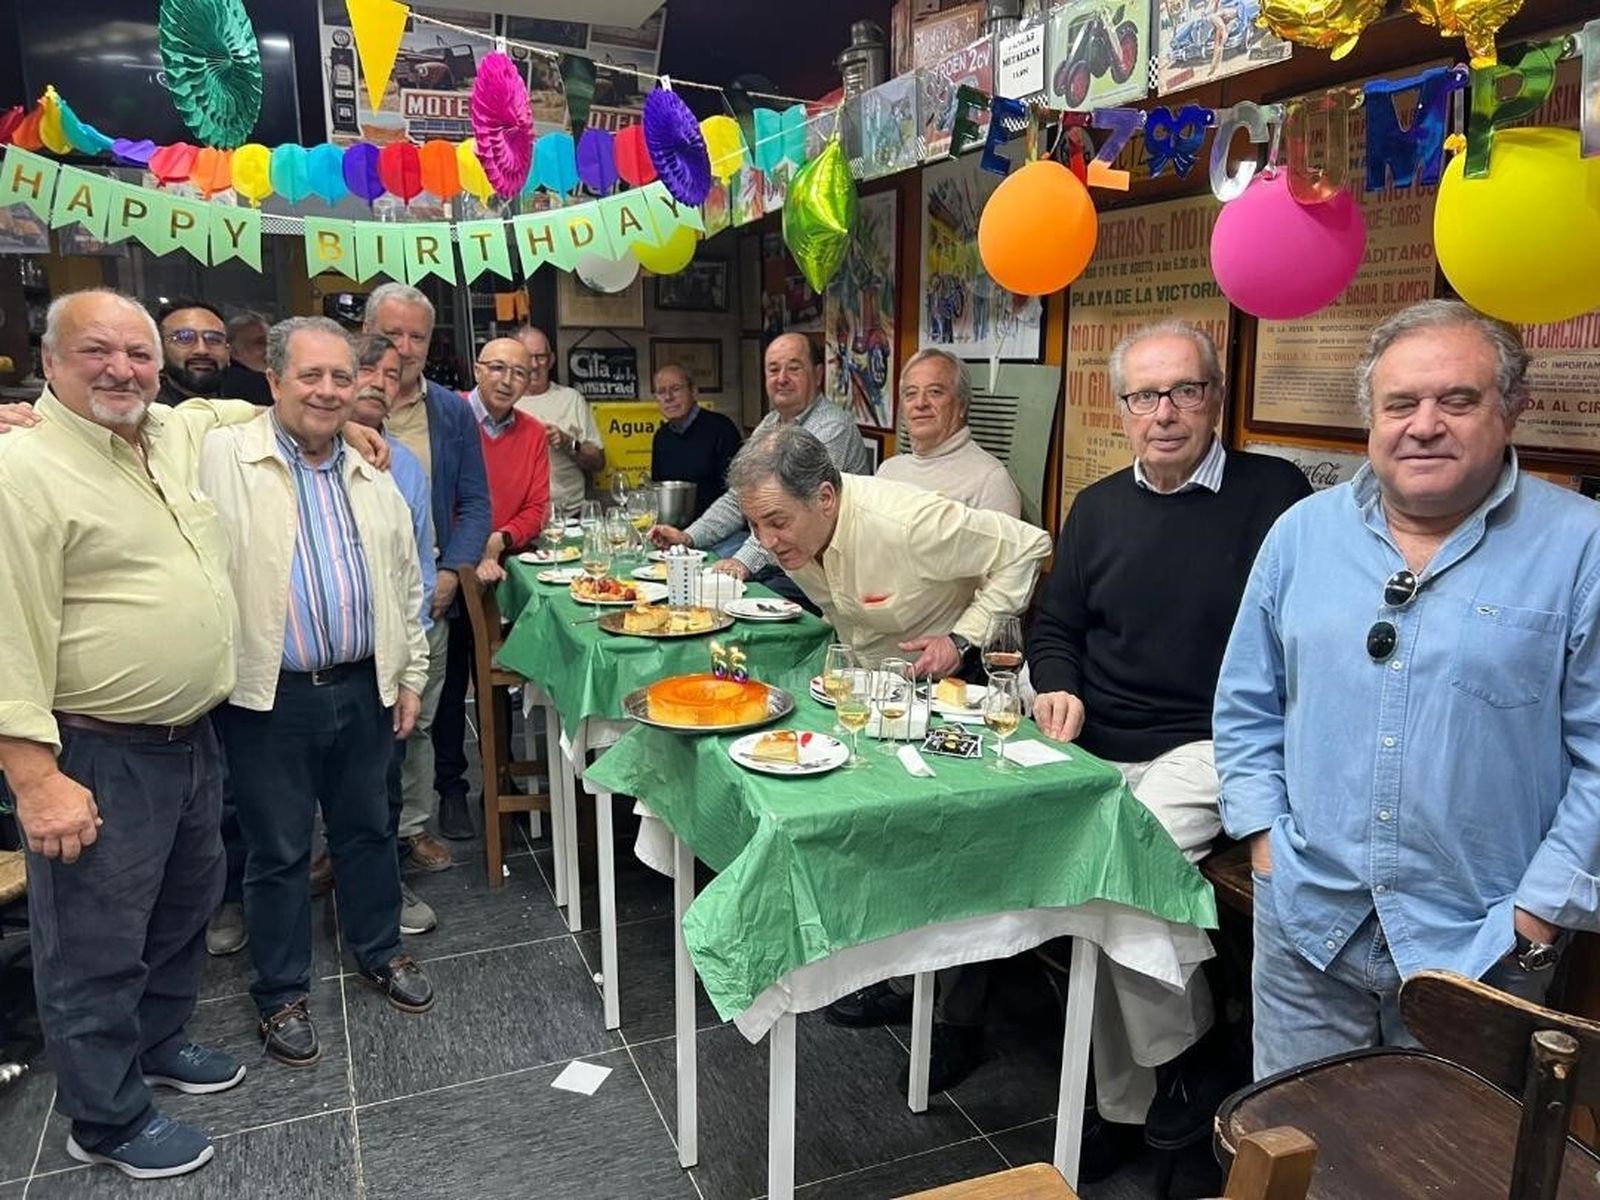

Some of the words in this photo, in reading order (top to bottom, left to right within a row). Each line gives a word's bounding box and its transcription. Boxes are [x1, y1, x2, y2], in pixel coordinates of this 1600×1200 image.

[969, 44, 991, 73] 2CV
[407, 94, 469, 116] MOTE
[11, 163, 248, 248] HAPPY
[317, 195, 681, 265] BIRTHDAY
[1150, 223, 1164, 254] DE
[1364, 243, 1433, 264] ADITANO
[1072, 289, 1112, 307] PLAYA
[1114, 289, 1132, 305] DE
[1135, 286, 1152, 303] LA
[1383, 280, 1429, 304] BLANCA
[1071, 324, 1105, 352] MOTO
[570, 351, 610, 378] Cita
[1069, 371, 1083, 406] VI
[1087, 370, 1116, 409] GRA
[1552, 399, 1570, 413] AL
[609, 419, 654, 438] Agua
